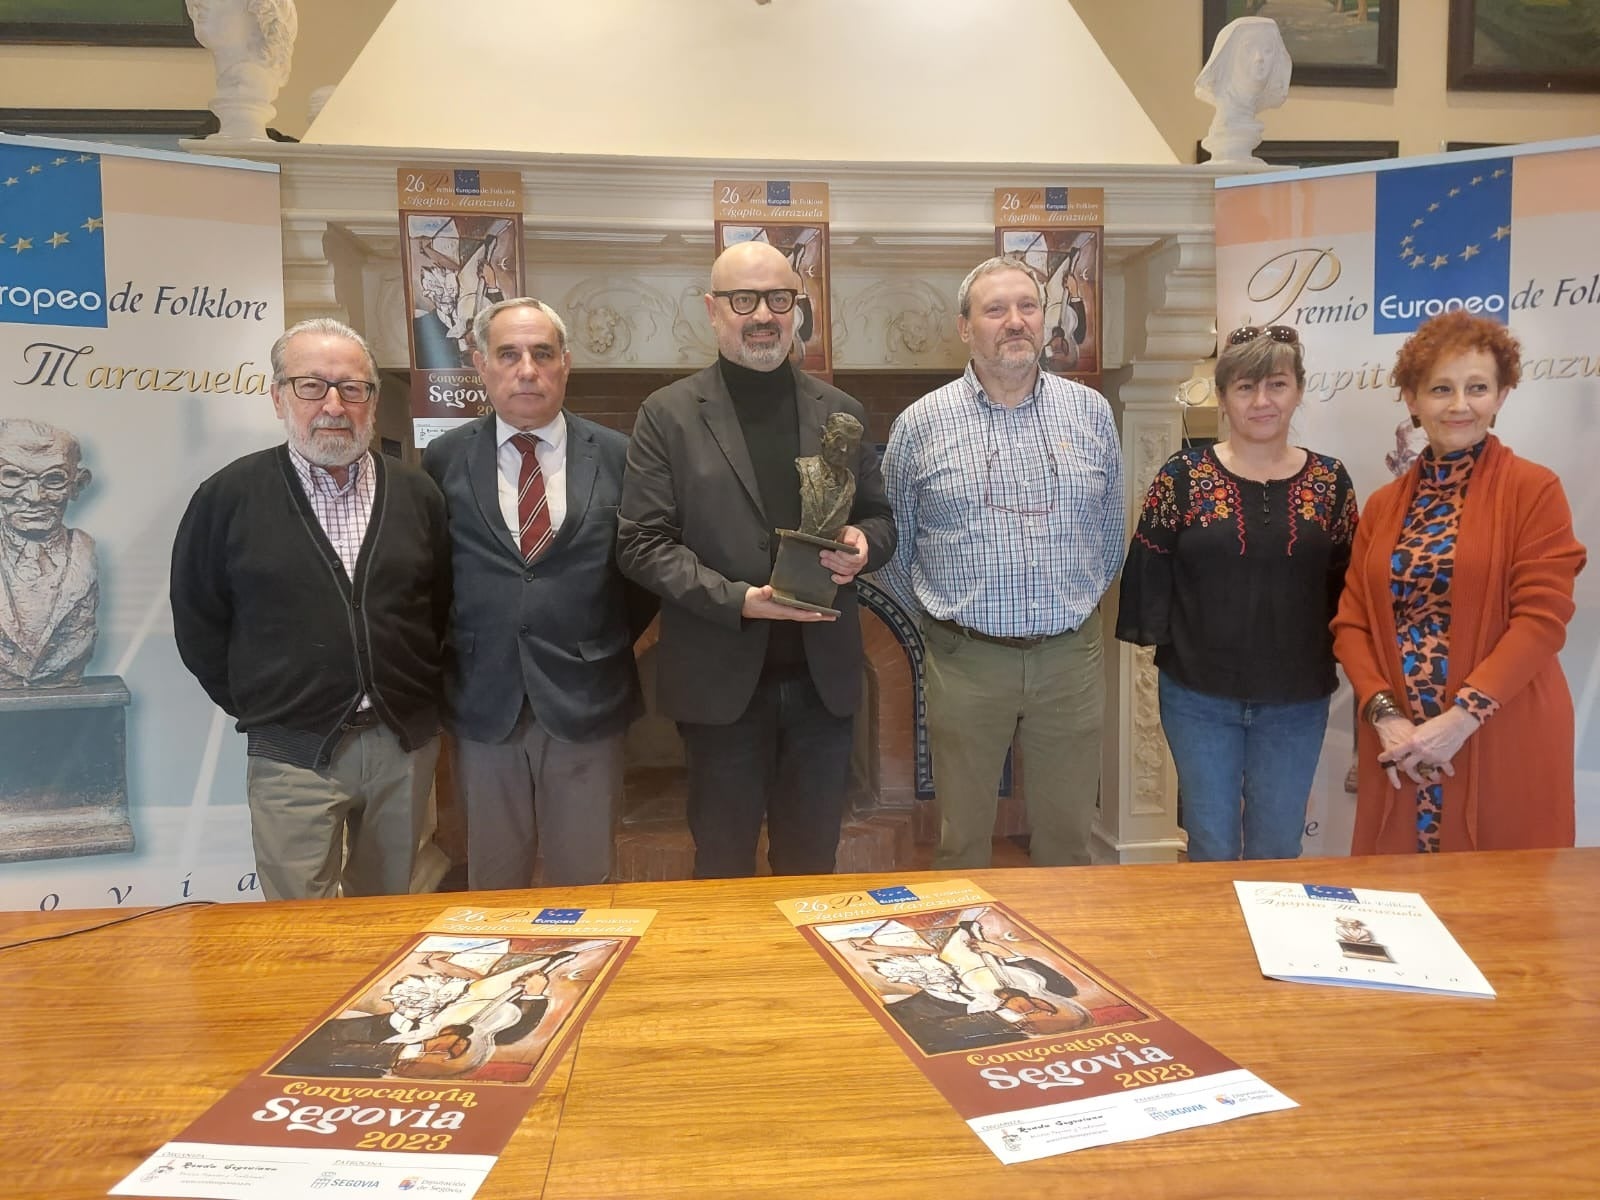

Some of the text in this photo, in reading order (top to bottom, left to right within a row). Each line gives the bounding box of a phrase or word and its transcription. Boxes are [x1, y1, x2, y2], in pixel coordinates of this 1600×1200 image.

[405, 174, 425, 193] 26
[720, 186, 740, 204] 26
[1001, 193, 1020, 210] 26
[1247, 247, 1368, 326] Premio
[1511, 279, 1544, 310] de
[1553, 273, 1600, 307] Fol
[0, 281, 268, 321] ropeo de Folklore
[13, 342, 269, 394] Marazuela
[428, 372, 484, 386] Convocat
[429, 385, 488, 409] Segov
[477, 405, 494, 417] 20
[446, 909, 487, 922] 26
[794, 899, 828, 913] 26
[966, 1031, 1151, 1067] Convocatoria
[980, 1045, 1175, 1090] Segovia
[1114, 1063, 1196, 1089] 2023
[282, 1081, 478, 1108] Convocatoria
[252, 1097, 466, 1134] Segovia
[355, 1131, 453, 1151] 2023
[330, 1178, 380, 1188] SEGOVIA
